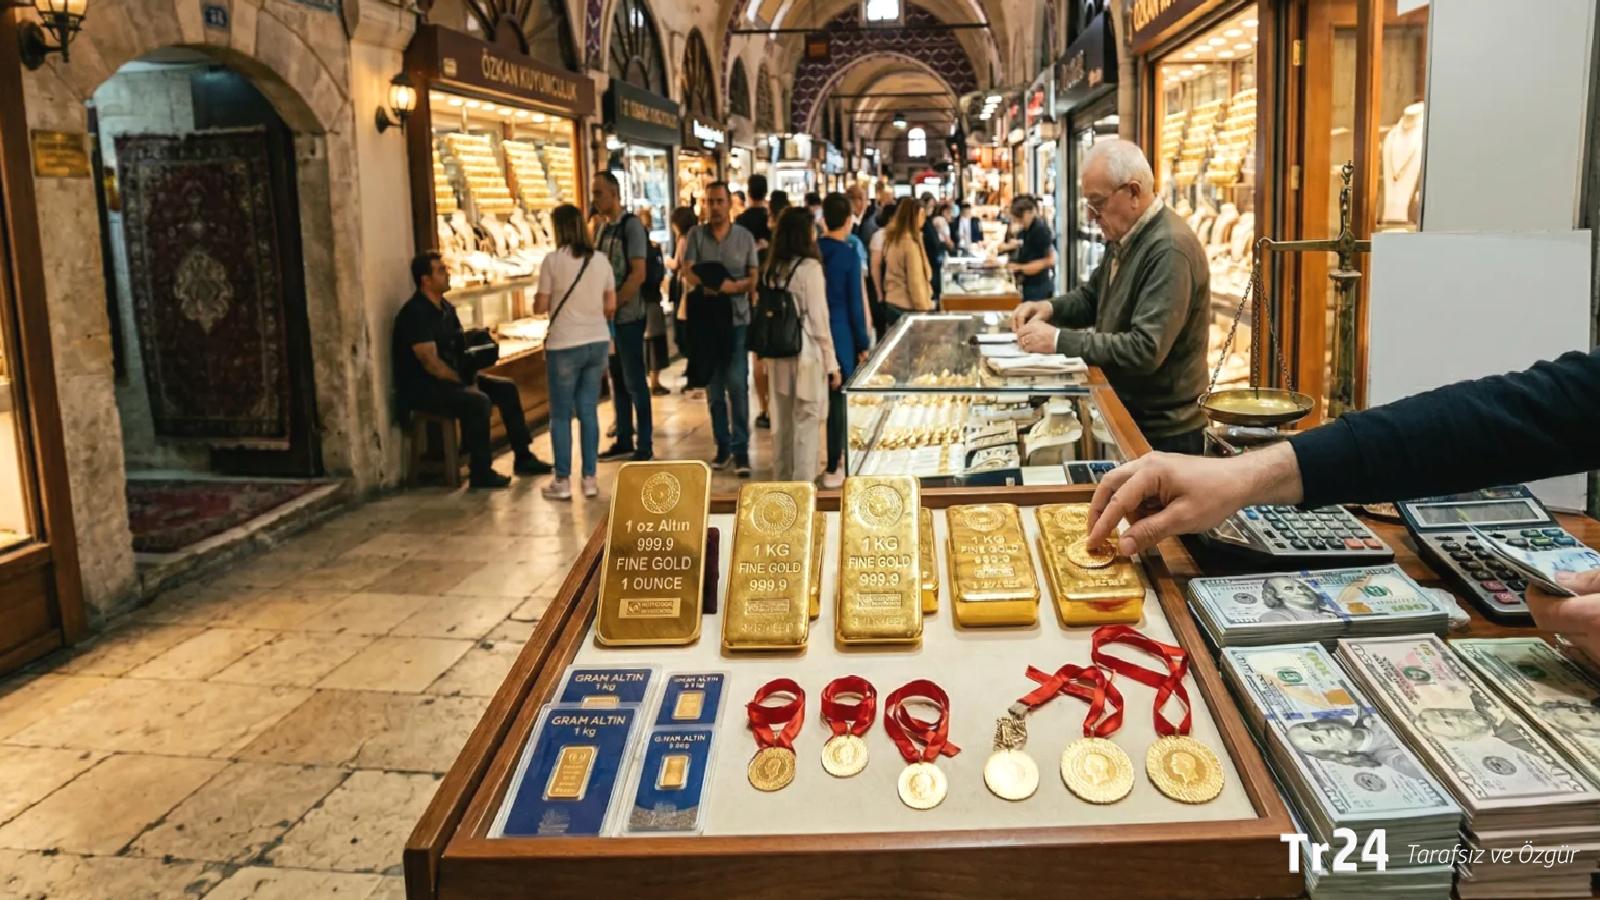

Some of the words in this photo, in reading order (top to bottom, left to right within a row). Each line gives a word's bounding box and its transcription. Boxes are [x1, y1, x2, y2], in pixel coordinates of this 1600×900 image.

[481, 47, 519, 87] ÖZKAN
[625, 519, 633, 533] 1
[636, 522, 655, 532] oz
[637, 537, 674, 552] 999.9
[862, 536, 871, 552] 1
[874, 535, 899, 552] KG
[971, 535, 978, 544] 1
[983, 534, 1006, 544] KG
[753, 544, 761, 557] 1
[766, 543, 790, 557] KG
[960, 545, 986, 554] FINE
[988, 544, 1020, 554] GOLD
[616, 556, 649, 571] FINE
[651, 556, 692, 571] GOLD
[738, 562, 766, 574] FINE
[768, 562, 801, 574] GOLD
[848, 555, 876, 569] FINE
[877, 554, 912, 569] GOLD
[621, 578, 629, 591] 1
[633, 577, 683, 590] OUNCE
[749, 579, 788, 592] 999.9
[859, 571, 900, 587] 999.9
[575, 674, 609, 682] GRAM
[611, 673, 645, 681] ALTIN
[602, 683, 616, 691] kg
[551, 716, 589, 725] GRAM
[590, 716, 626, 725] ALTIN
[582, 728, 596, 738] kg
